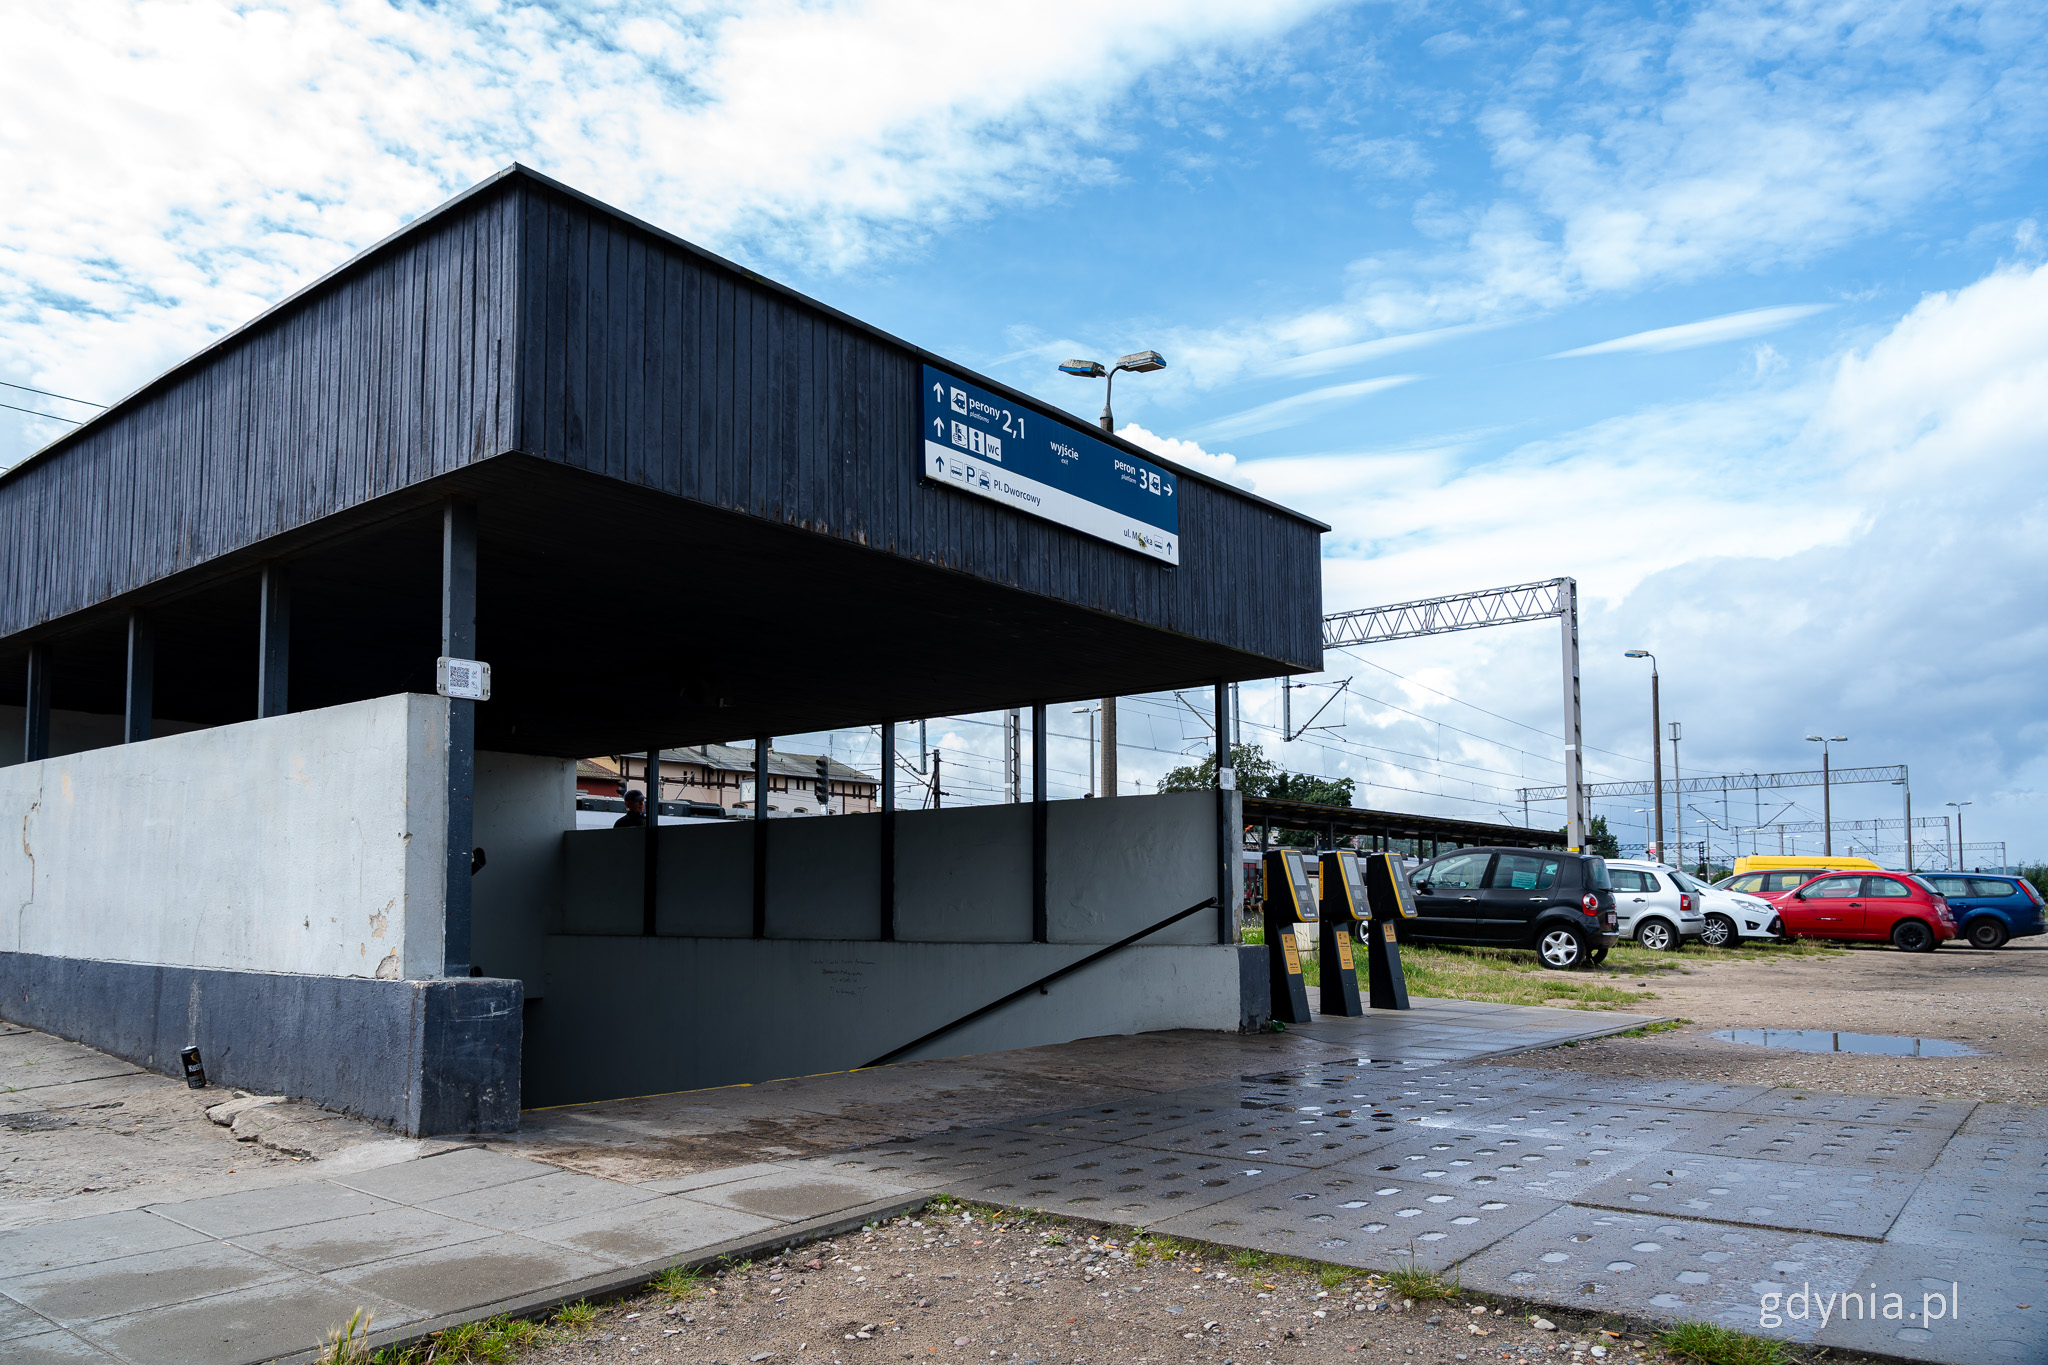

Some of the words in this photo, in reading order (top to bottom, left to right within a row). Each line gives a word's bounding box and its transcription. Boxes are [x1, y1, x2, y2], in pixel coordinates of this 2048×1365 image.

[969, 398, 1000, 421] perony
[1002, 409, 1024, 439] 2,1
[970, 411, 989, 423] platforms
[988, 443, 999, 456] WC
[1050, 441, 1079, 461] wyjście
[1114, 459, 1136, 476] peron
[1139, 468, 1148, 490] 3
[993, 479, 1003, 492] Pl.
[1003, 483, 1041, 507] Dworcowy
